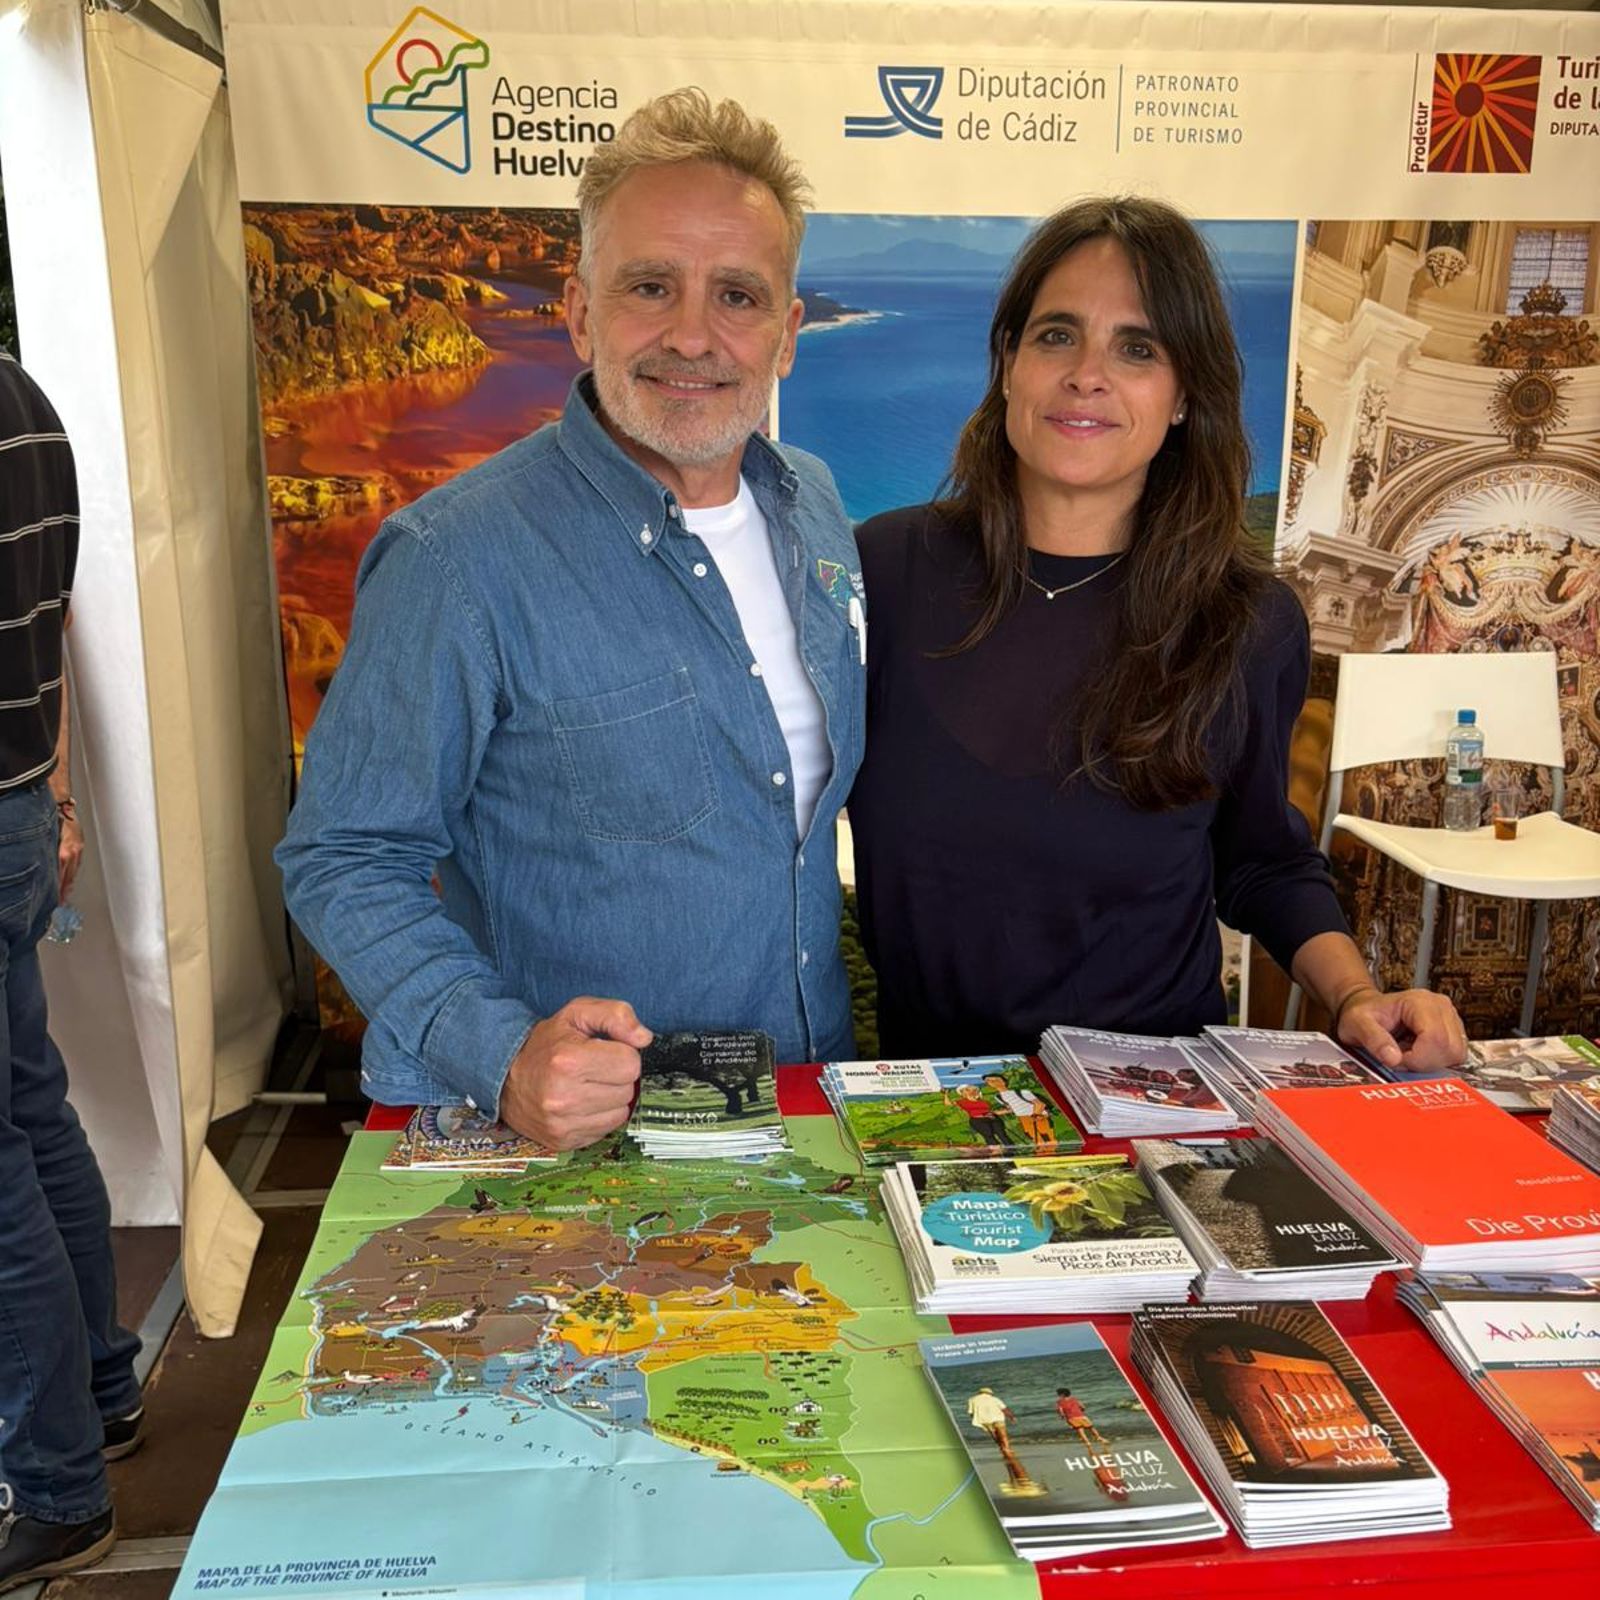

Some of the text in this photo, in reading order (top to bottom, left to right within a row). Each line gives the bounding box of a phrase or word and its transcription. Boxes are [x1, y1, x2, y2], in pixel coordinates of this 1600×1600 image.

[958, 67, 1106, 102] Diputación
[1135, 75, 1239, 93] PATRONATO
[491, 77, 618, 113] Agencia
[1554, 86, 1581, 109] de
[1134, 101, 1239, 118] PROVINCIAL
[491, 112, 616, 143] Destino
[957, 112, 1077, 142] de Cádiz
[1133, 127, 1243, 145] DE TURISMO
[1550, 122, 1600, 136] DIPUTA
[1410, 102, 1429, 173] Prodetur
[493, 147, 593, 177] Huelv
[1359, 1082, 1463, 1100] HUELVA
[647, 1109, 718, 1120] HUELVA
[952, 1200, 1010, 1211] Mapa
[960, 1224, 1024, 1235] Tourist
[1275, 1221, 1353, 1236] HUELVA
[1465, 1216, 1525, 1236] Die
[973, 1236, 1020, 1248] Map
[951, 1256, 997, 1266] aets
[1032, 1249, 1182, 1264] Sierra de Aracena y
[1060, 1260, 1103, 1271] Picos
[1105, 1258, 1128, 1268] de
[1130, 1256, 1188, 1267] Aroche
[1484, 1321, 1600, 1342] Andalucía
[1291, 1422, 1389, 1441] HUELVA
[404, 1421, 657, 1496] OCÉANO ATLÁNTICO
[1065, 1449, 1160, 1471] HUELVA
[197, 1556, 437, 1578] MAPA DE LA PROVINCIA DE HUELVA
[193, 1567, 428, 1590] MAP OF THE PROVINCE OF HUELVA
